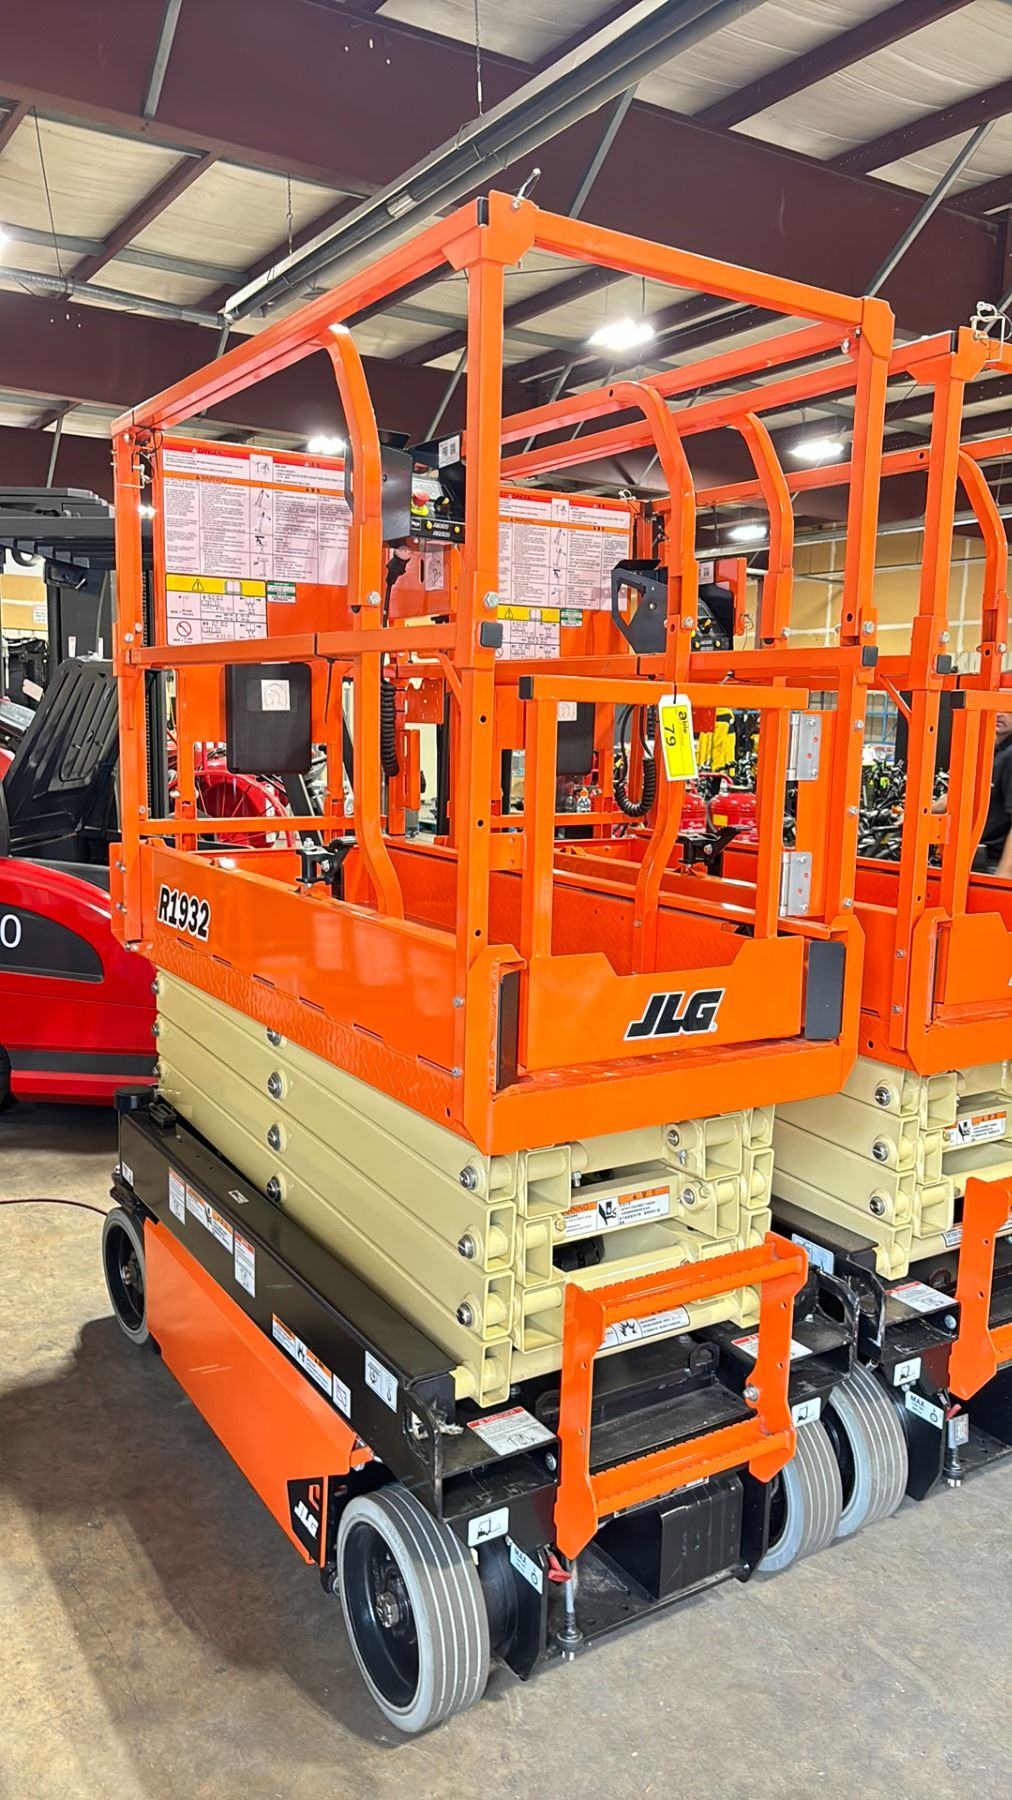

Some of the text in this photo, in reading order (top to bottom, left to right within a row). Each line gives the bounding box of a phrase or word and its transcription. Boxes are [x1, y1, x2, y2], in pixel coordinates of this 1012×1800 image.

[664, 723, 677, 746] 79
[158, 885, 210, 939] R1932
[624, 988, 725, 1041] JLG
[294, 1500, 319, 1539] JLG
